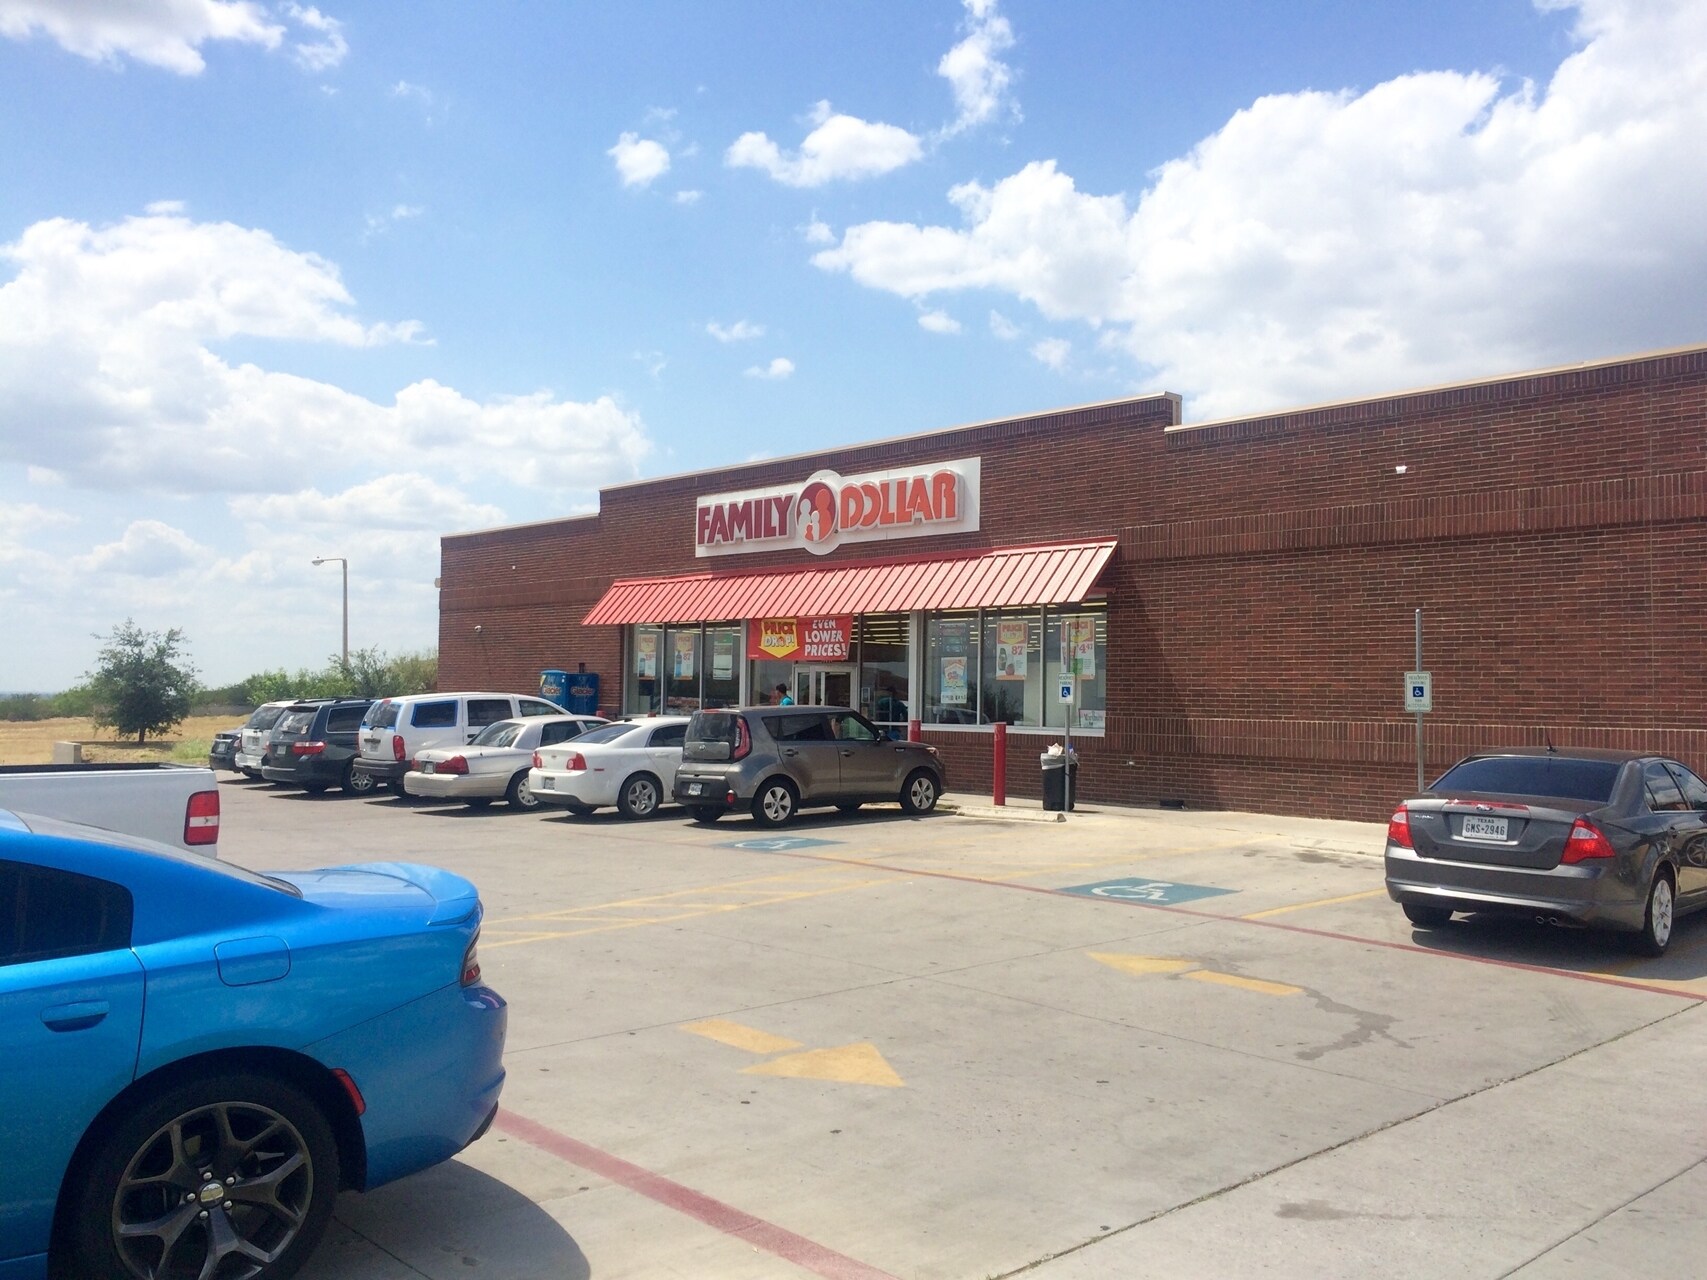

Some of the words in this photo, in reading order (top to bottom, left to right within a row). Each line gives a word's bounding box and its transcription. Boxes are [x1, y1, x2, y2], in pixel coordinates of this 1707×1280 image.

[697, 495, 793, 545] FAMILY
[840, 472, 957, 529] DOLLAR
[763, 621, 794, 635] PRICE
[812, 620, 836, 630] EVEN
[804, 630, 844, 643] LOWER
[804, 642, 847, 656] PRICES!
